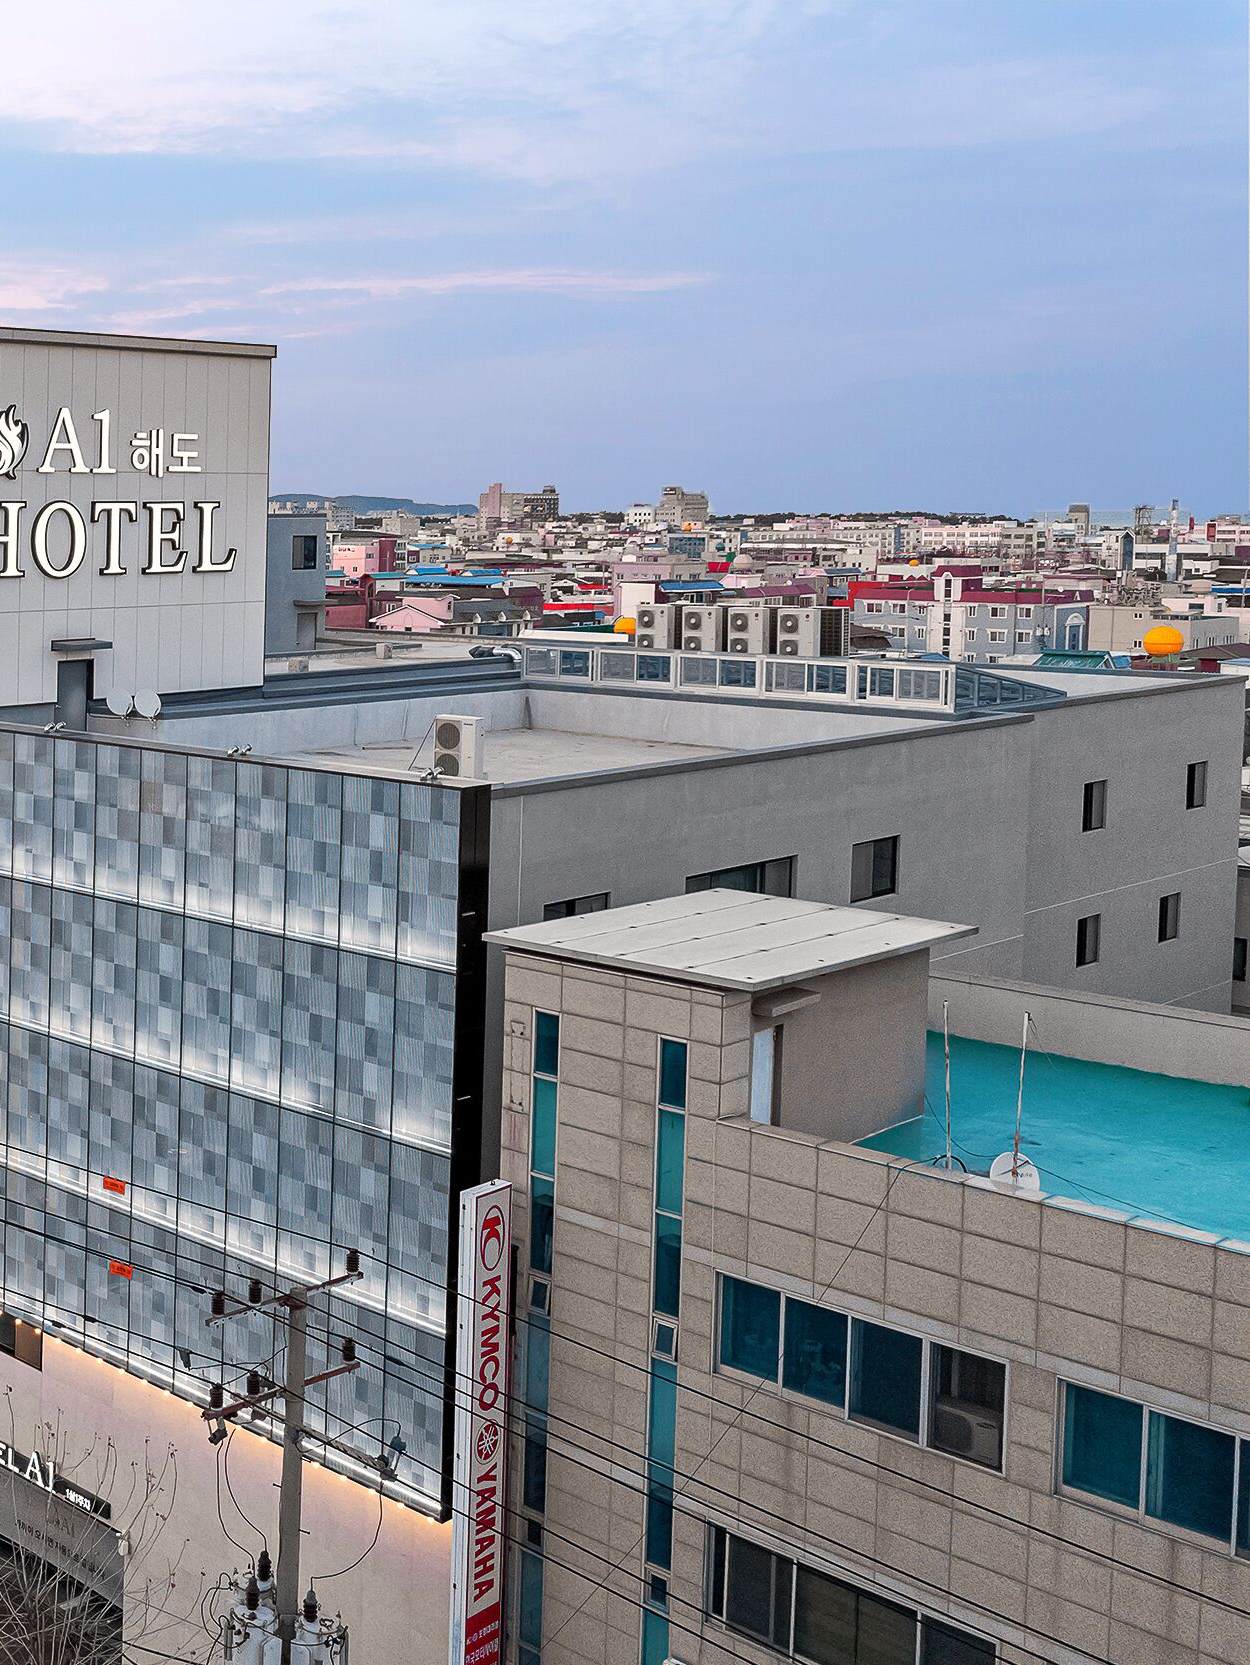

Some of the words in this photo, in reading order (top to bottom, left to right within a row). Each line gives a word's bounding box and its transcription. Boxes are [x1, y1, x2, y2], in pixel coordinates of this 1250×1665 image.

[36, 406, 117, 475] A1
[128, 428, 203, 478] 해도
[477, 1273, 503, 1412] KYMCO
[24, 1450, 57, 1495] A1
[473, 1461, 499, 1604] YAMAHA
